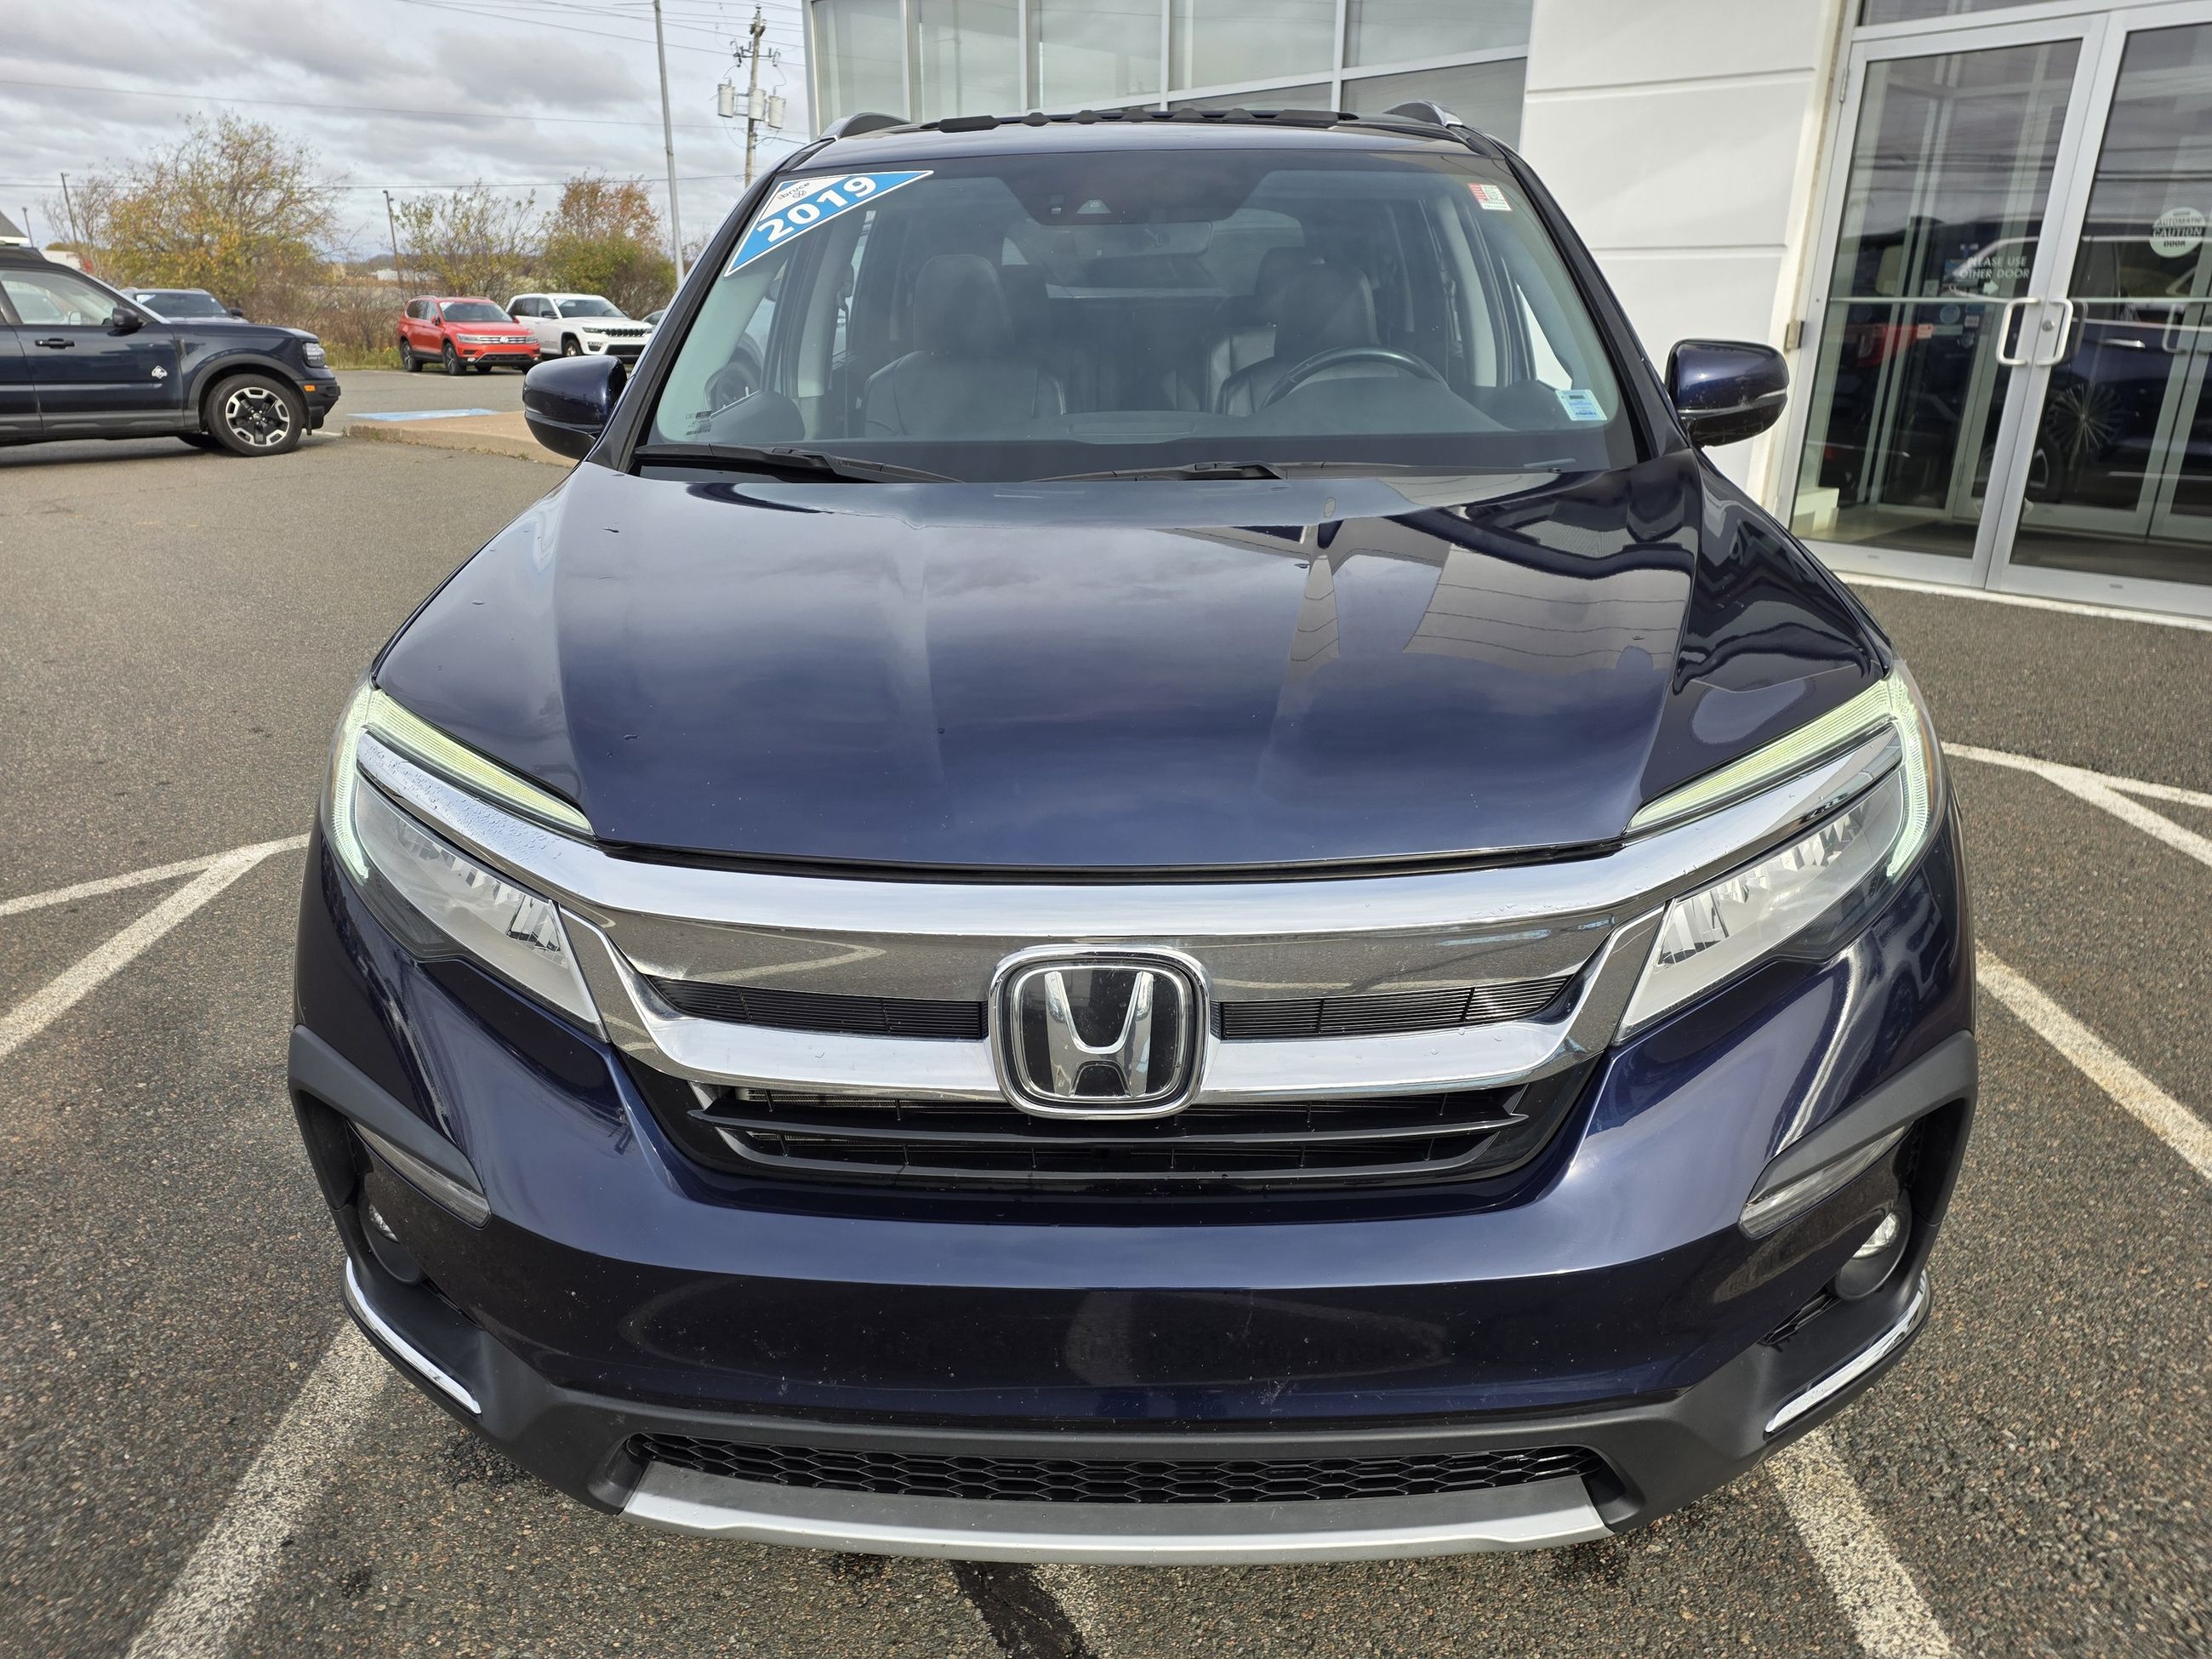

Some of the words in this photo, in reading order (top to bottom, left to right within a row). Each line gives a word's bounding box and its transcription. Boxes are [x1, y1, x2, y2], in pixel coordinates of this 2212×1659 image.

[780, 182, 810, 198] bruce
[757, 177, 876, 242] 2019
[2152, 227, 2203, 238] CAUTION
[1967, 256, 2004, 268] PLEASE
[2008, 256, 2027, 267] USE
[1959, 269, 1992, 280] OTHER
[1996, 269, 2030, 279] DOOR
